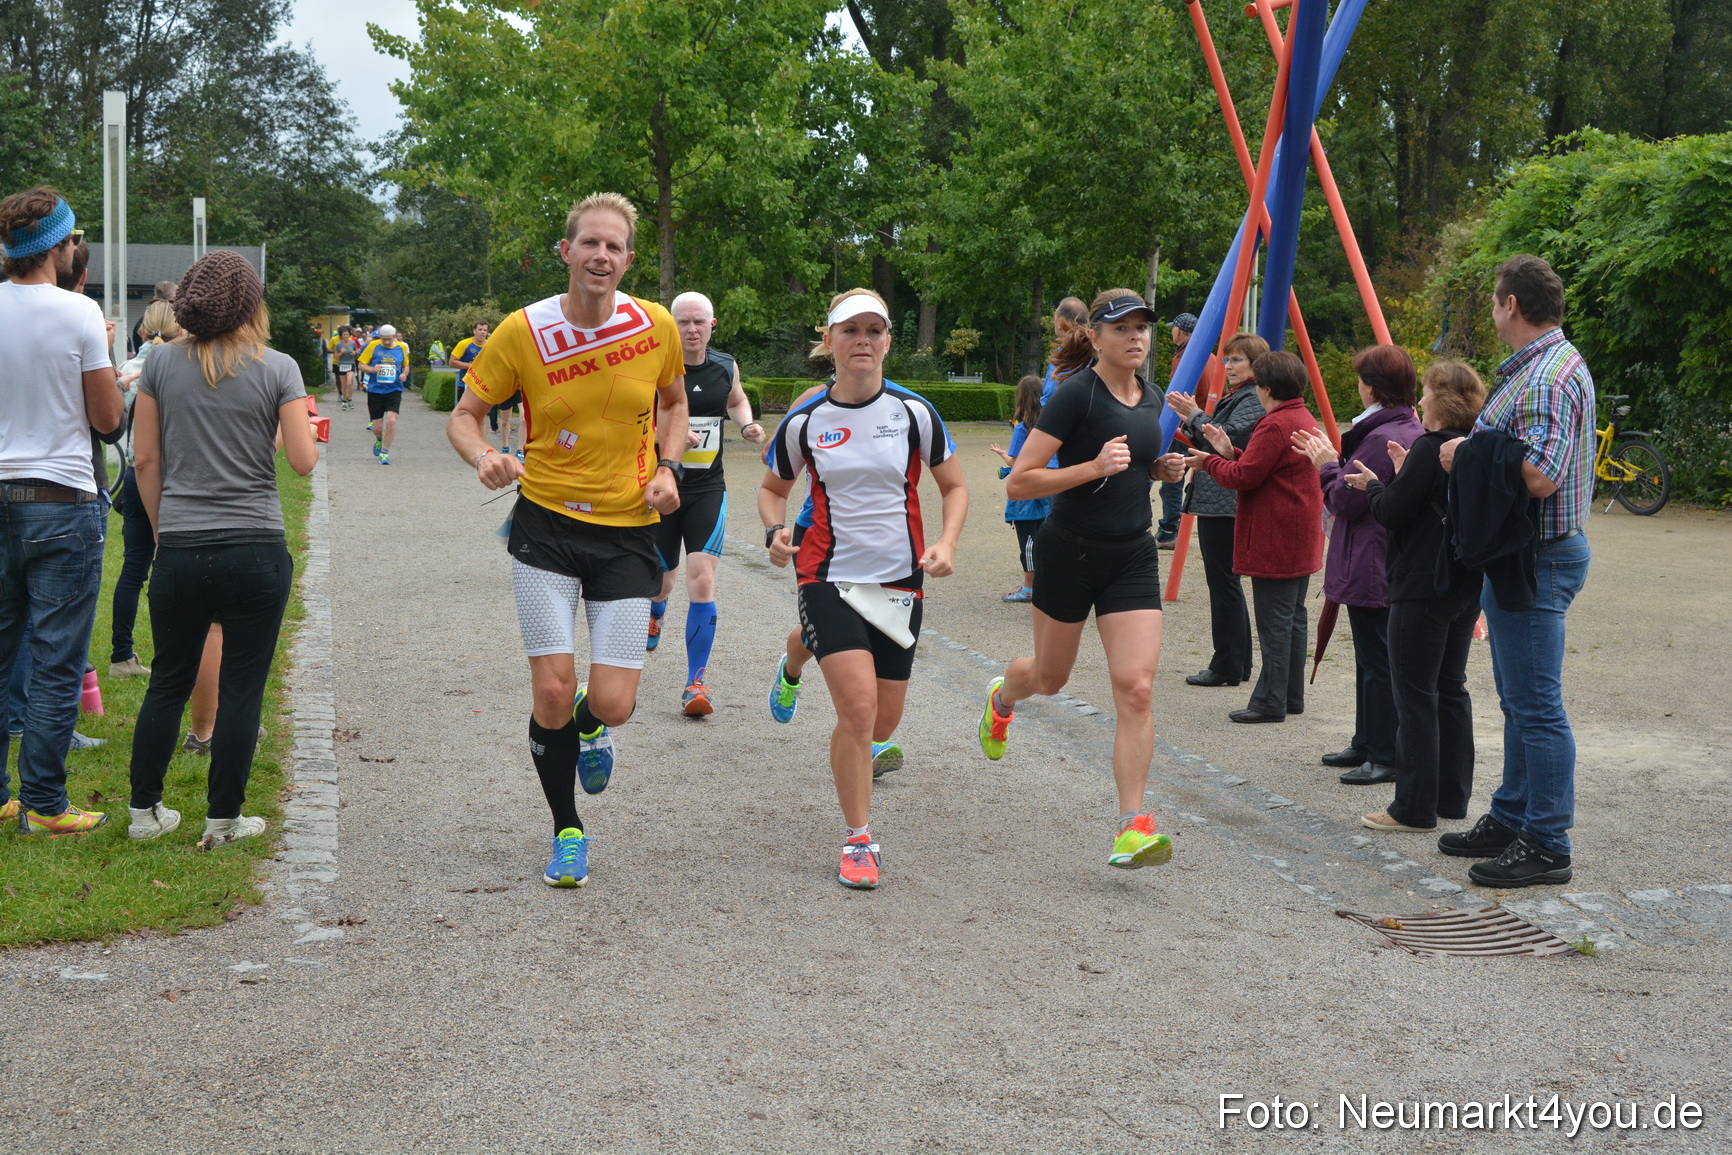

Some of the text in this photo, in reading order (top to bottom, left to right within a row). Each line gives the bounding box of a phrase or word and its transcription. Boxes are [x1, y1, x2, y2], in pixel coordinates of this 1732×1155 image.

[547, 336, 661, 387] MAX BÖGL
[818, 431, 842, 443] tkn
